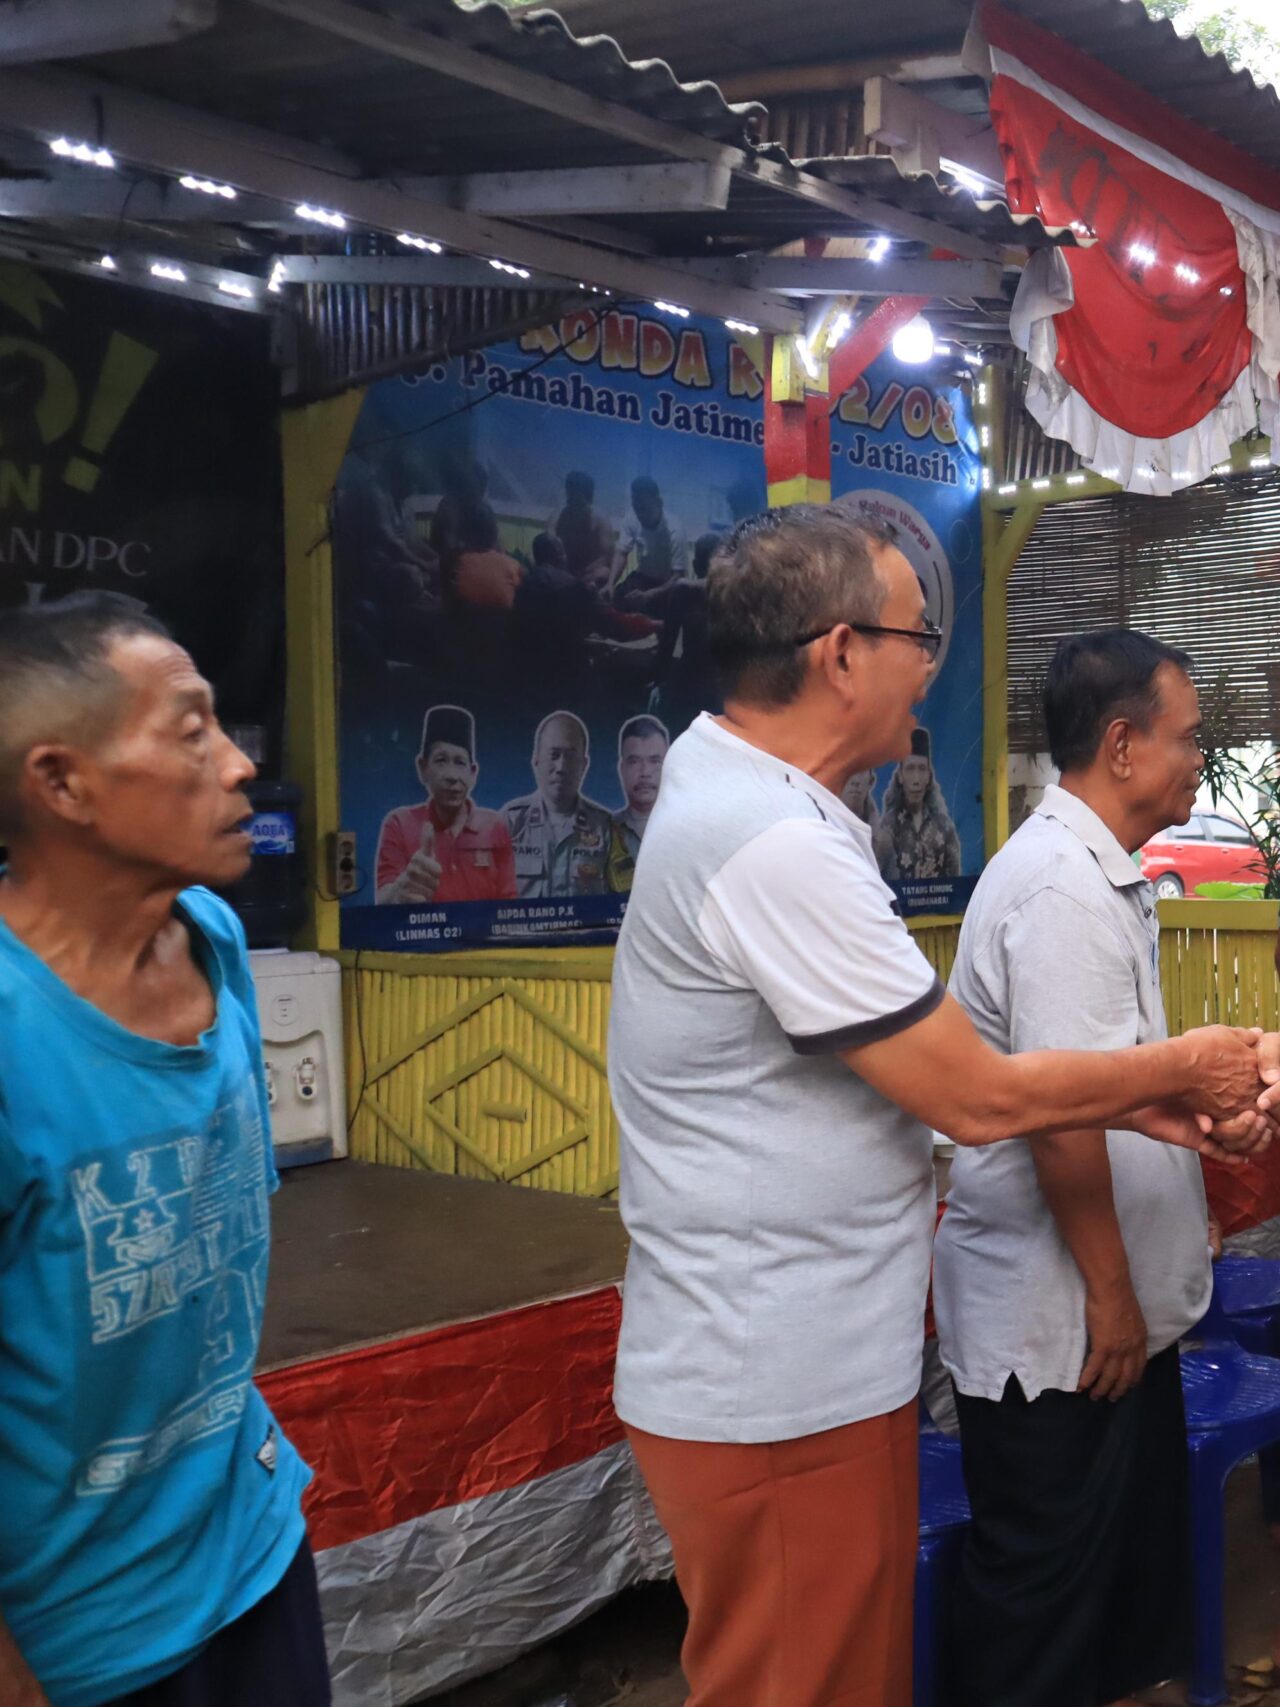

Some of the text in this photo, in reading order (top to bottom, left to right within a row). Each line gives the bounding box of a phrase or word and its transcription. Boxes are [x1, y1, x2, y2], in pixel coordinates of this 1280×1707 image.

[461, 350, 641, 423] Pamahan
[651, 392, 765, 447] Jatime
[850, 434, 958, 485] Jatiasih
[828, 374, 958, 446] 2/08
[53, 532, 151, 577] DPC
[253, 823, 286, 838] AQUA
